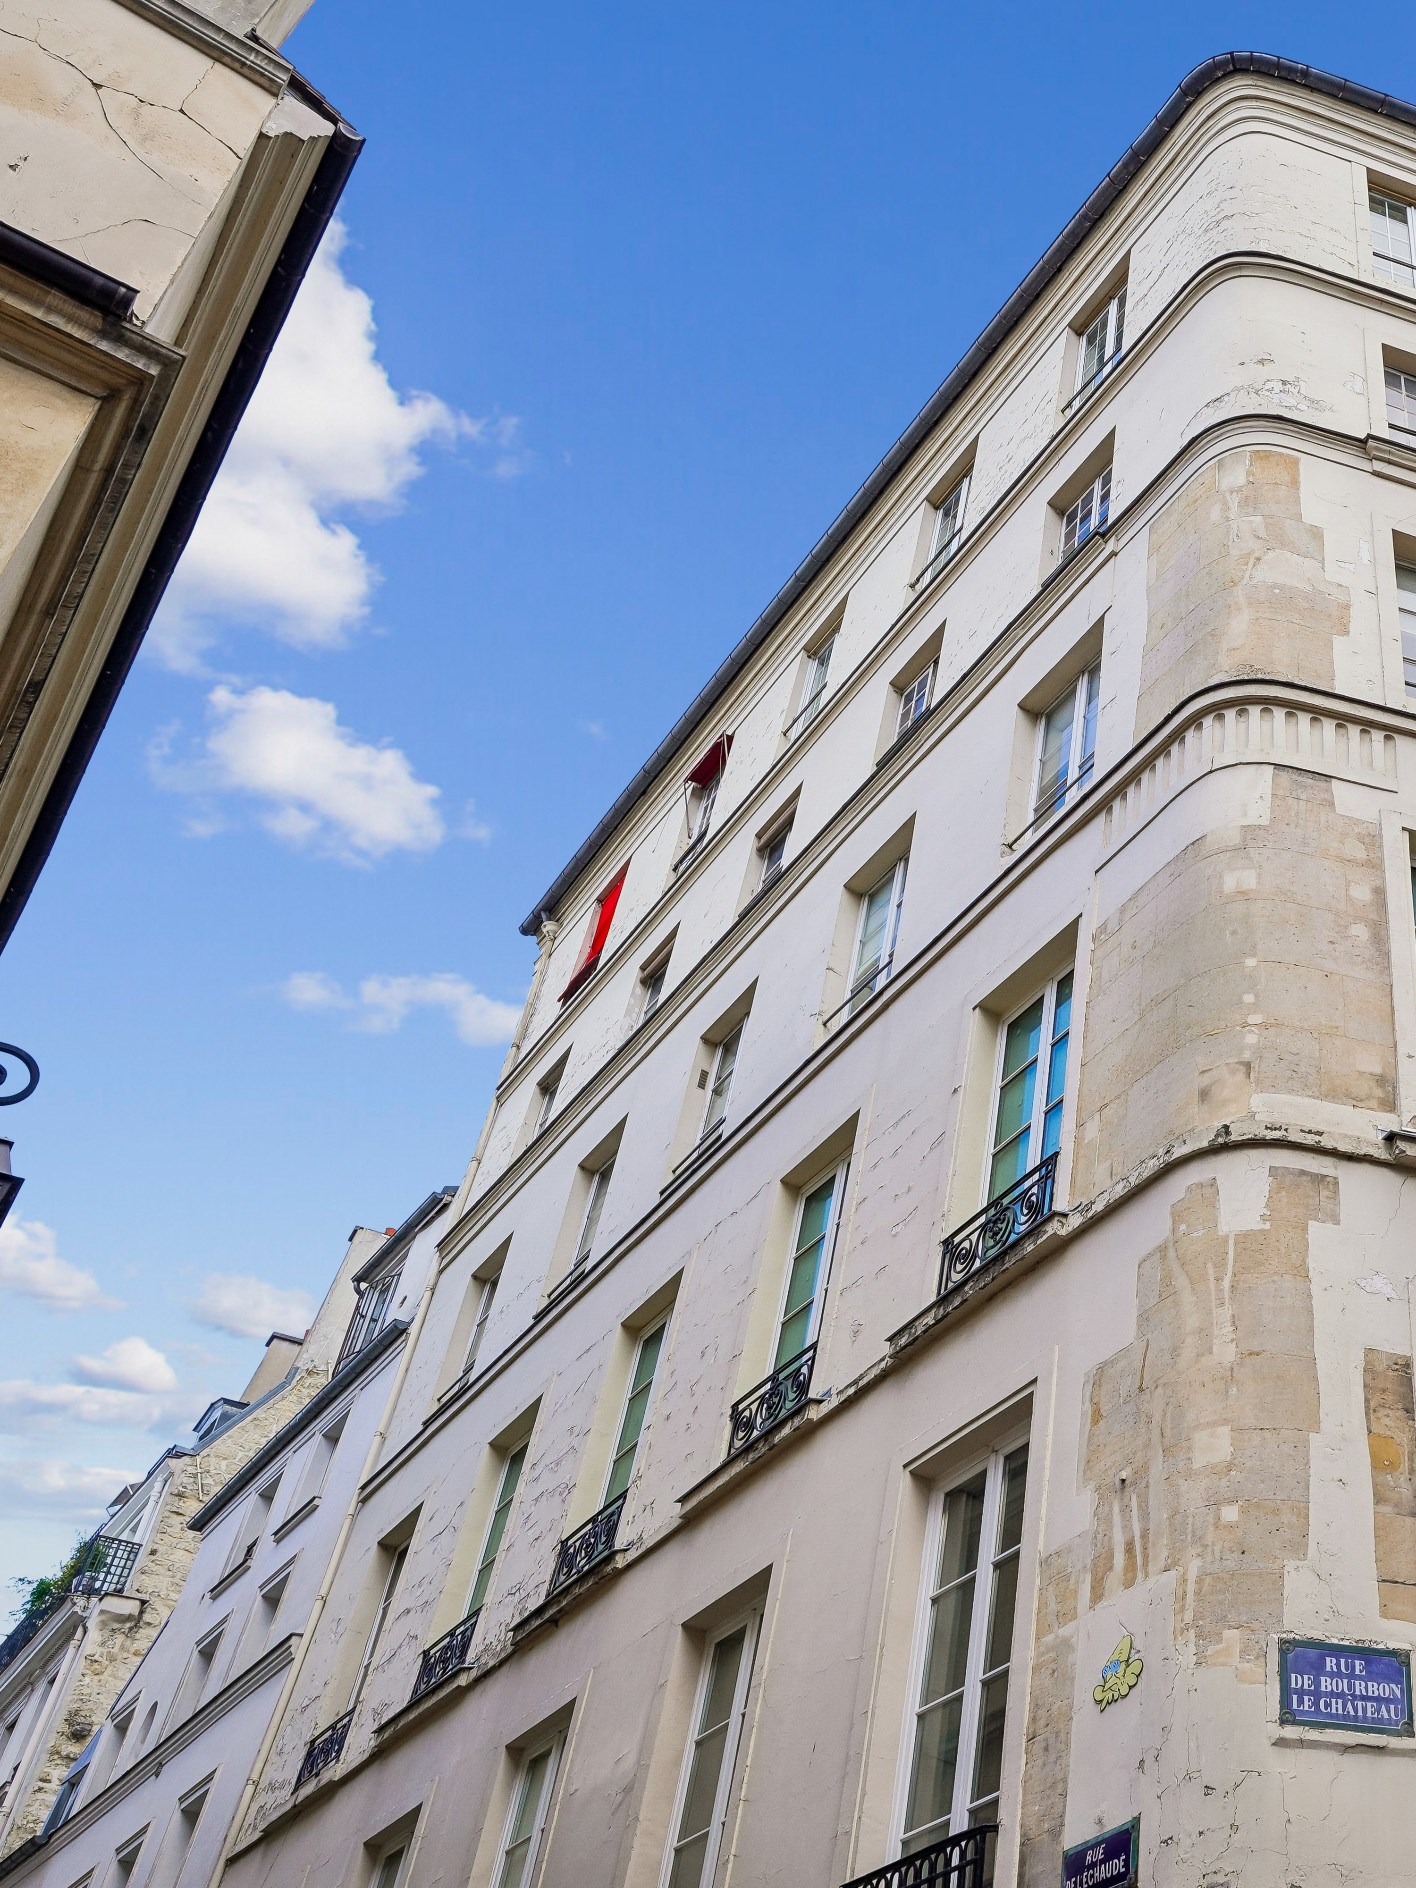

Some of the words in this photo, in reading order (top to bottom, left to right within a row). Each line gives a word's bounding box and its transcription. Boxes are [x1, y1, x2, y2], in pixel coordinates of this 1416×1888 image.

[1325, 1656, 1365, 1675] RUE
[1290, 1673, 1314, 1690] DE
[1320, 1676, 1402, 1699] BOURBON
[1292, 1695, 1315, 1711] LE
[1319, 1696, 1401, 1720] CHÂTEAU
[1085, 1843, 1105, 1865] RUE
